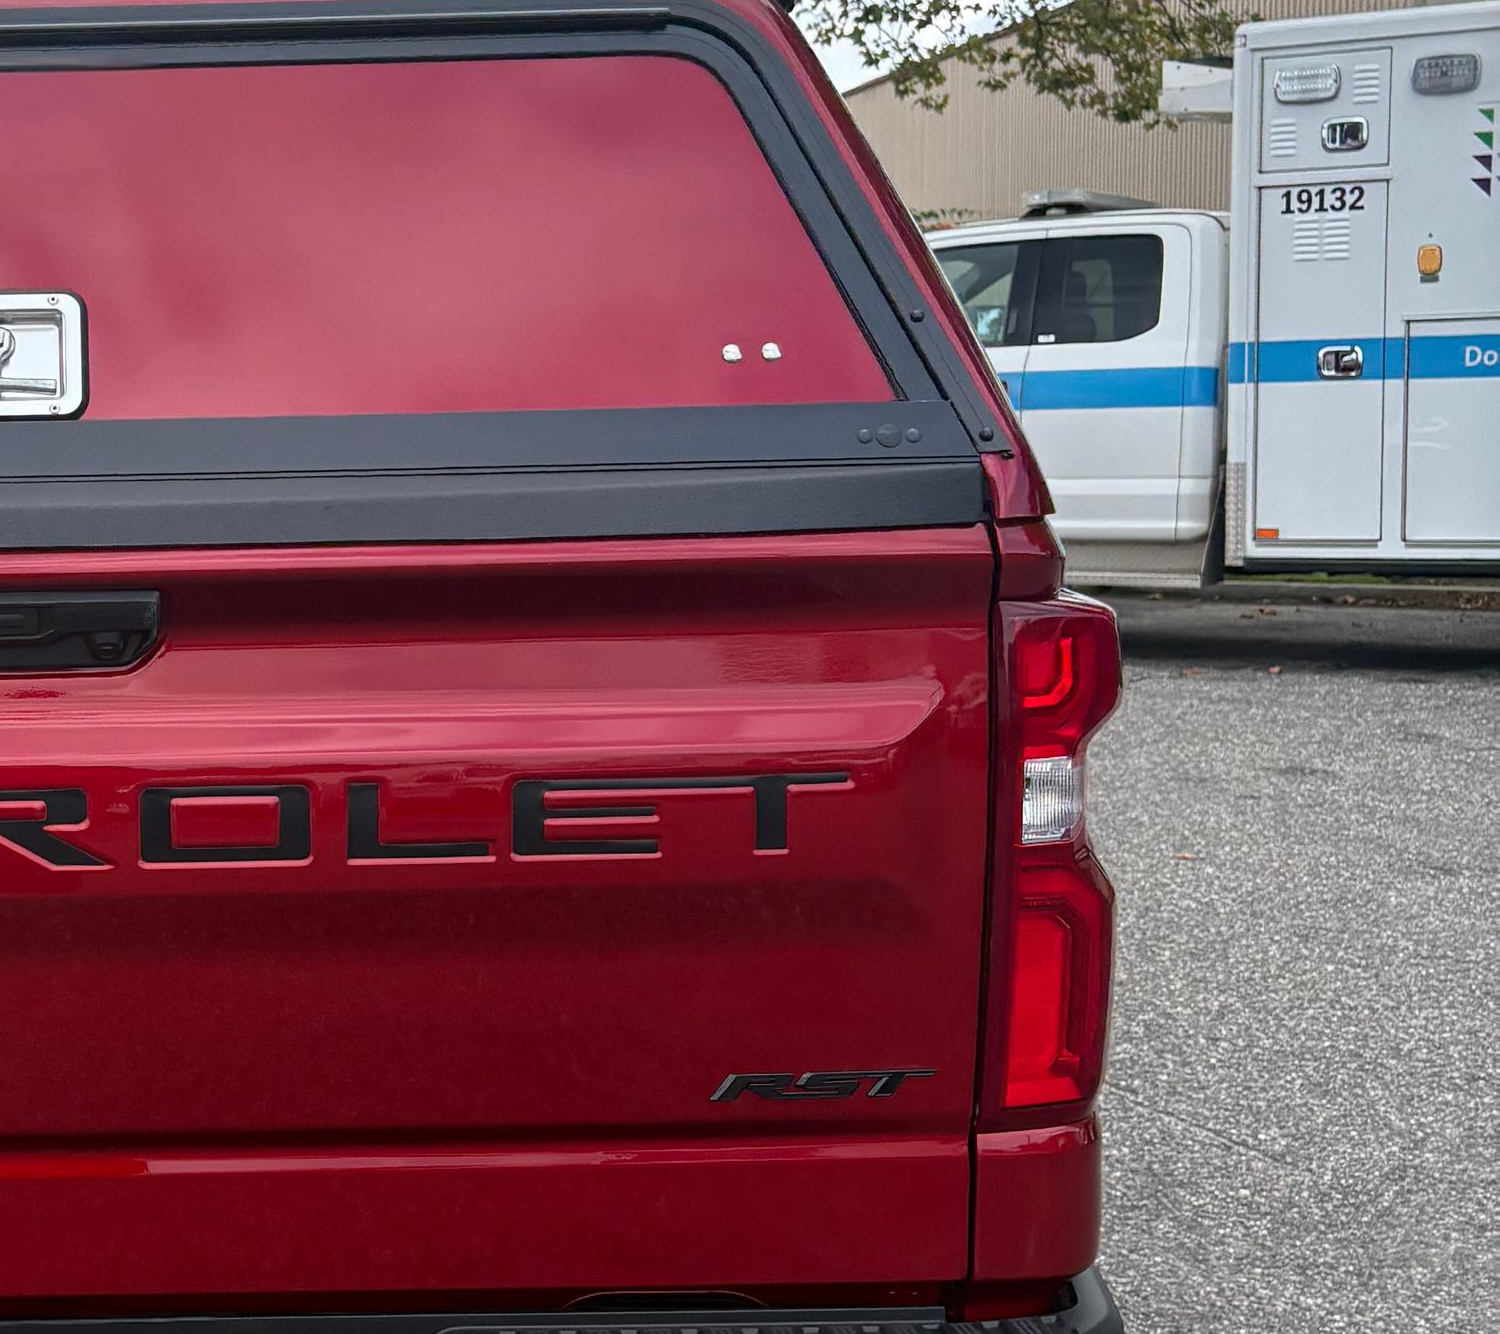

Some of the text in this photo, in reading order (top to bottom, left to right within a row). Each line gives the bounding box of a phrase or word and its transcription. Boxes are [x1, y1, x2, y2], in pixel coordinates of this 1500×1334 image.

[1281, 185, 1365, 214] 19132
[1464, 345, 1498, 368] Do
[709, 1069, 937, 1101] RST
